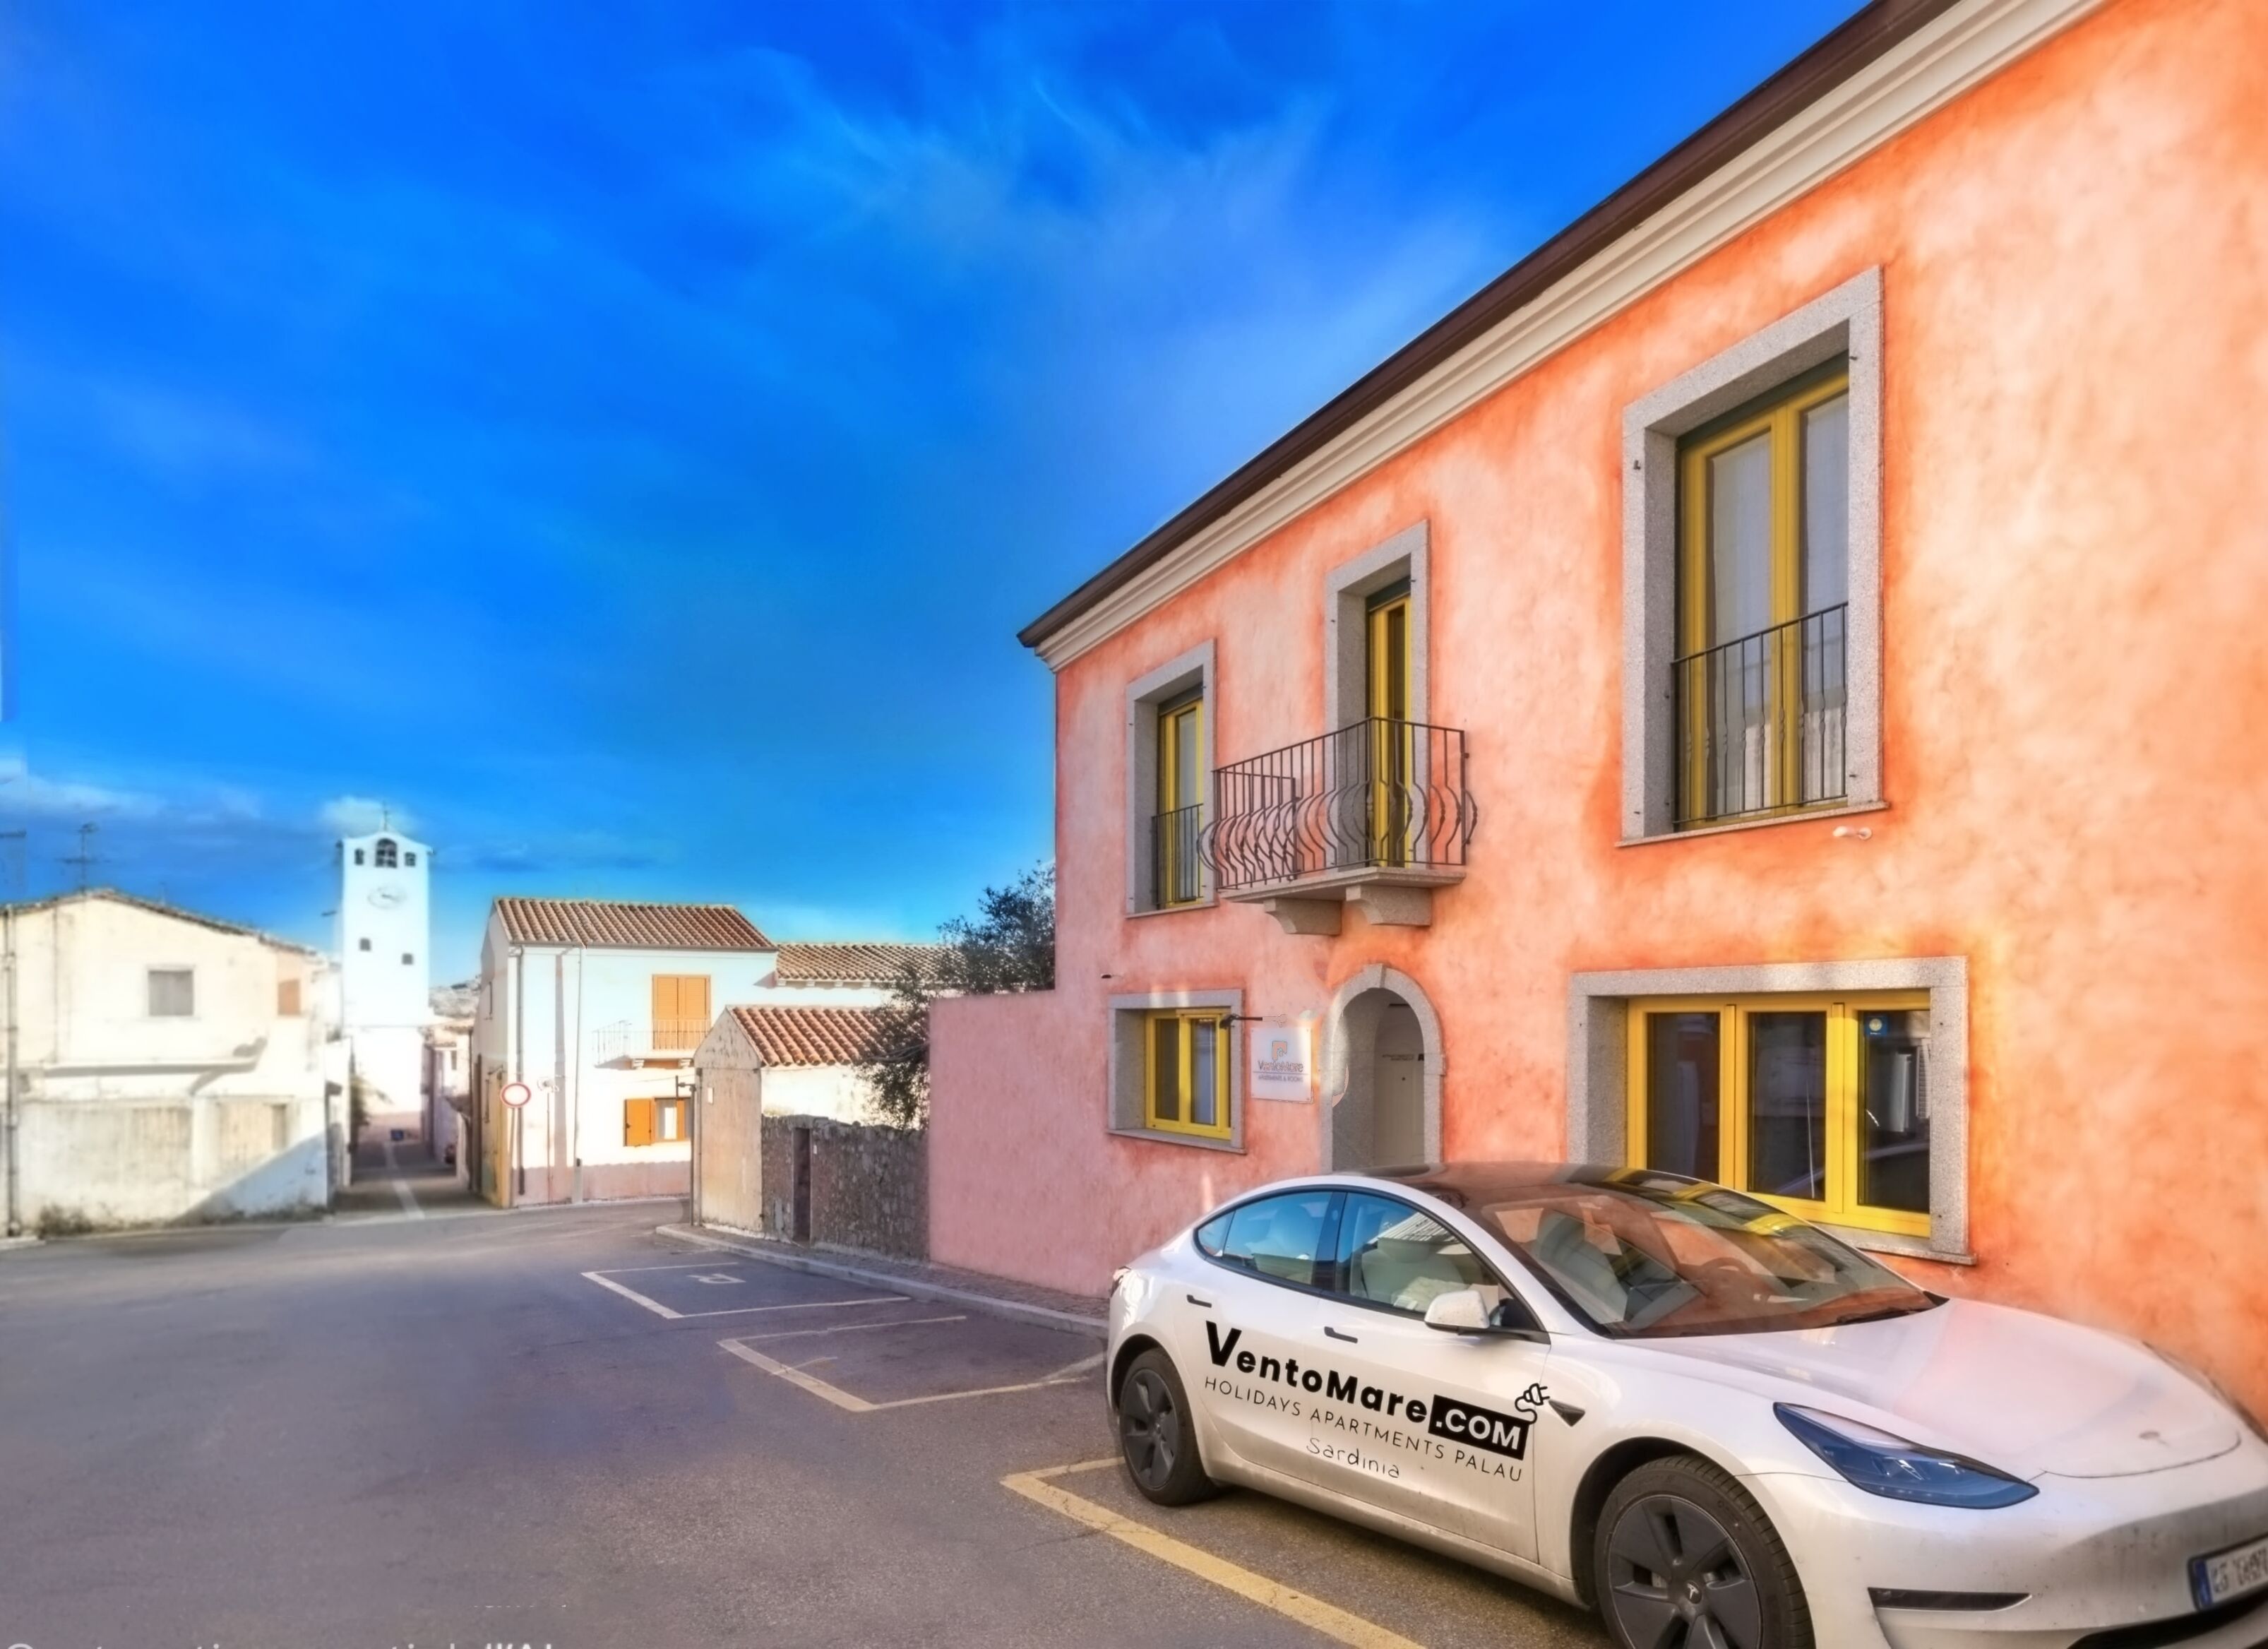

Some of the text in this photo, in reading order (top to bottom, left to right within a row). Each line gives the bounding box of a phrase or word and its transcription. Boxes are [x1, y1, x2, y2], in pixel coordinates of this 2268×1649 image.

[1205, 1376, 1522, 1482] HOLIDAYS APARTMENTS PALAU
[1306, 1437, 1399, 1479] Sardinia
